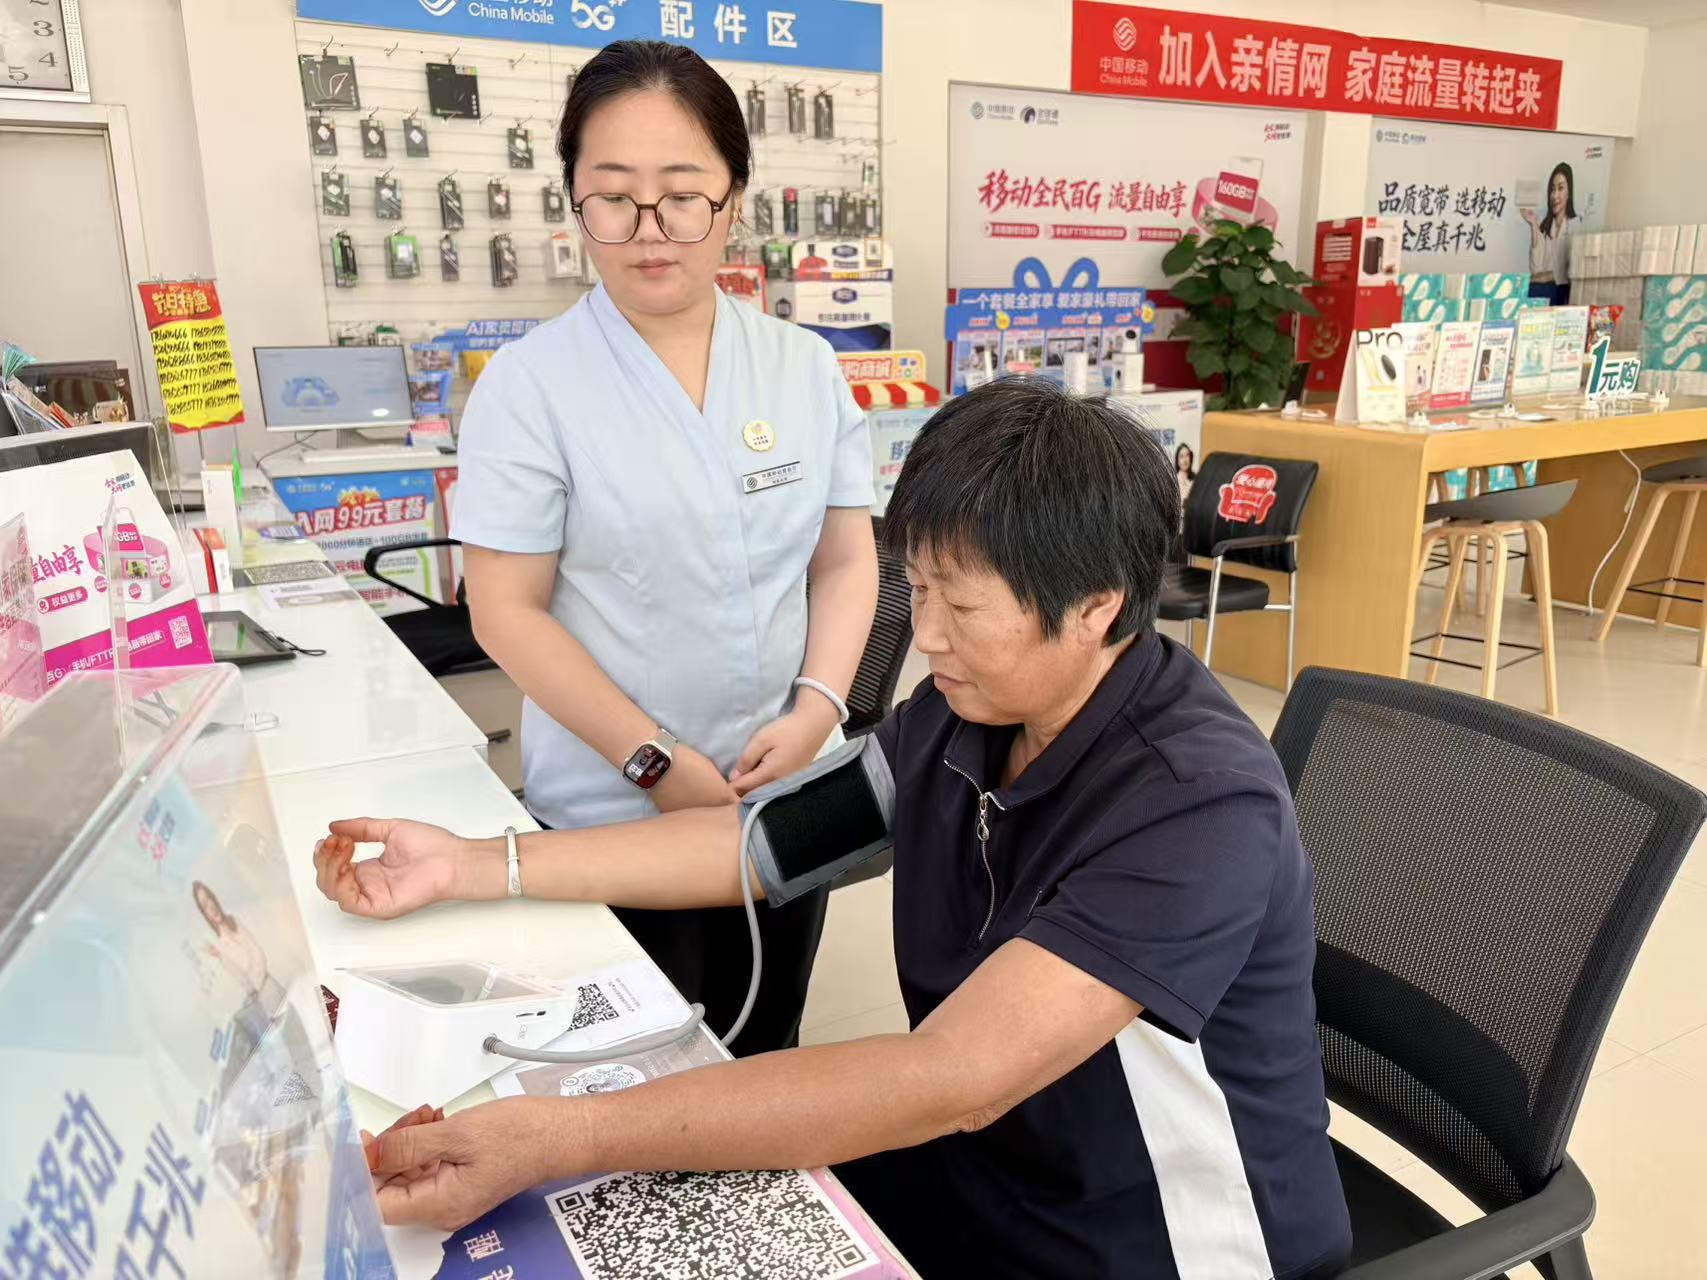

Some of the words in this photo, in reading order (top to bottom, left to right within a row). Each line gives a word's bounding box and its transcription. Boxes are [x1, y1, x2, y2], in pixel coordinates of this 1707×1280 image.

[33, 20, 54, 37] 3
[468, 3, 509, 20] China
[510, 6, 555, 25] Mobile
[660, 0, 798, 48] 配件区
[8, 65, 29, 81] 5
[38, 52, 58, 67] 4
[1100, 56, 1148, 75] 中国移动
[1158, 24, 1332, 99] 加入亲情网
[1344, 46, 1542, 118] 家庭流量转起来
[978, 168, 1101, 214] 移动全民百G
[1108, 179, 1187, 218] 流量自由享
[1378, 182, 1448, 216] 品质宽带
[1454, 188, 1507, 219] 选移动
[1589, 340, 1638, 394] 1元购
